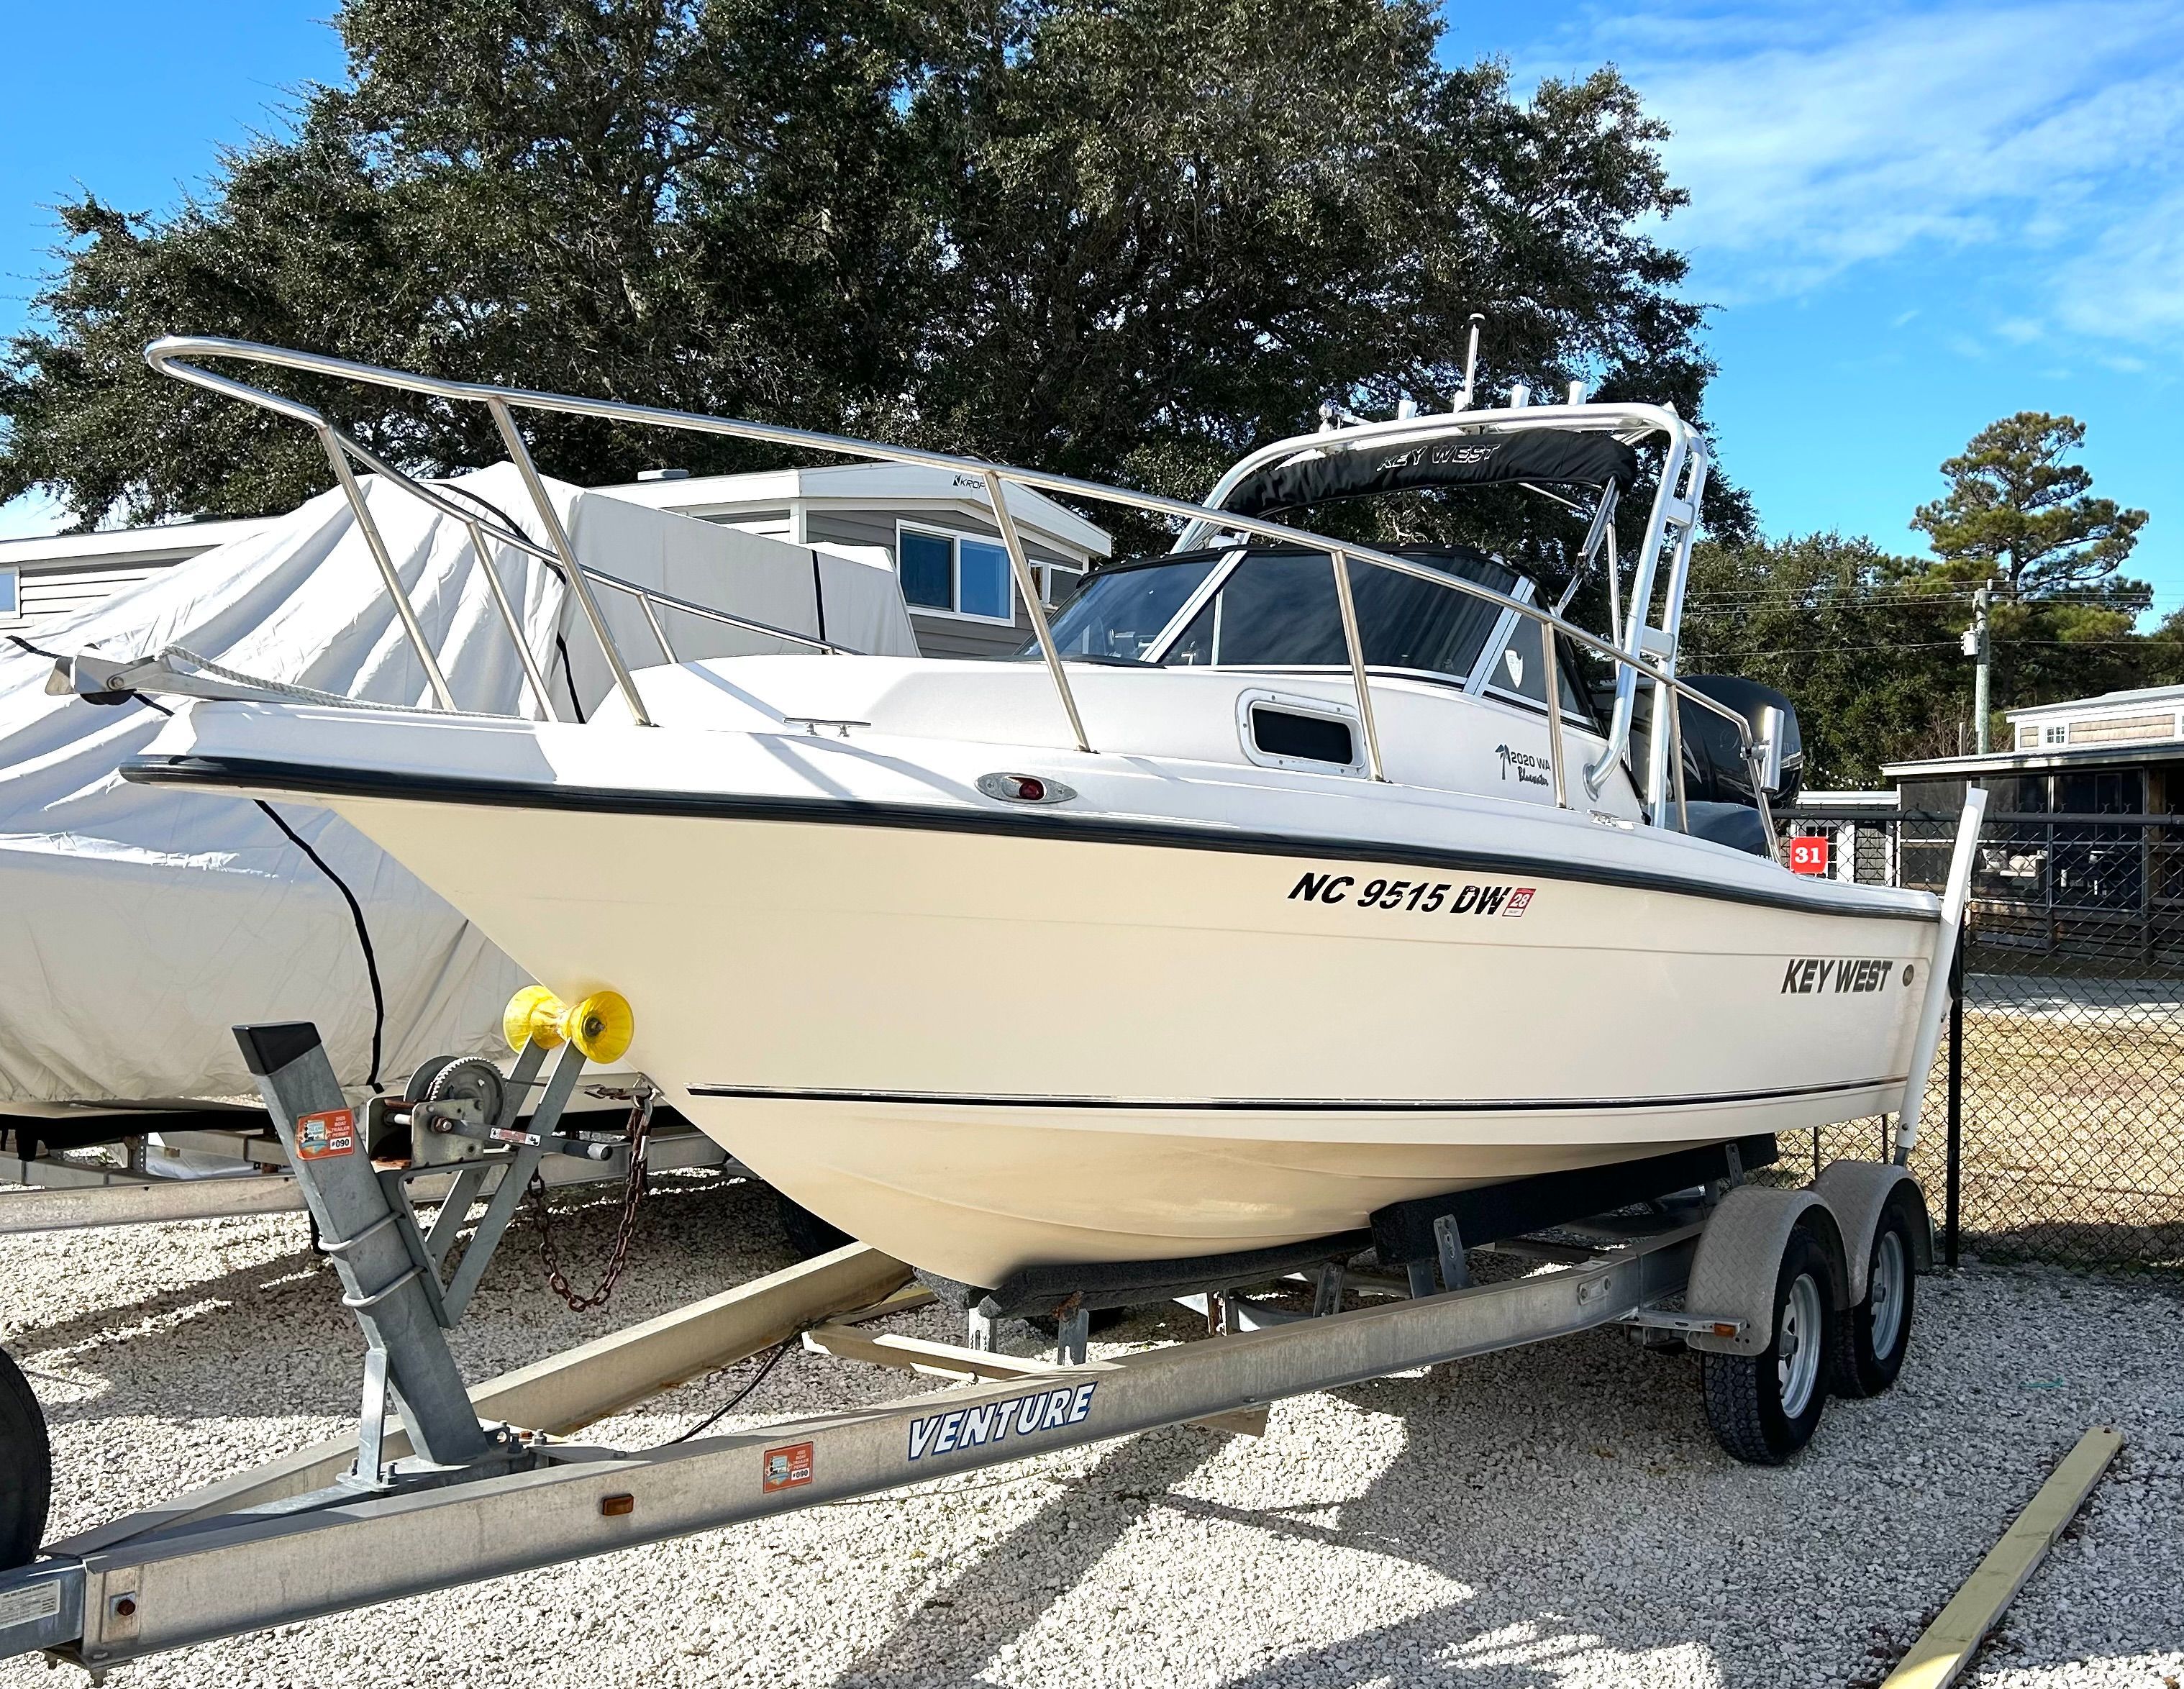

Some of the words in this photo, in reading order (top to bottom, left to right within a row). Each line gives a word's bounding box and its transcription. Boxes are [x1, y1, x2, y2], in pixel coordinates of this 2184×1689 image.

[1376, 445, 1428, 472] KEY
[1432, 443, 1501, 464] WEST
[1511, 751, 1535, 768] 2020
[1536, 757, 1551, 772] WA
[1794, 847, 1821, 864] 31
[1288, 873, 1355, 903] NC
[1357, 879, 1452, 912] 9515
[1450, 886, 1513, 915] DW
[1780, 959, 1835, 994] KEY
[1835, 960, 1893, 993] WEST
[331, 1139, 350, 1147] #090
[908, 1381, 1098, 1461] VENTURE
[792, 1469, 809, 1478] #090
